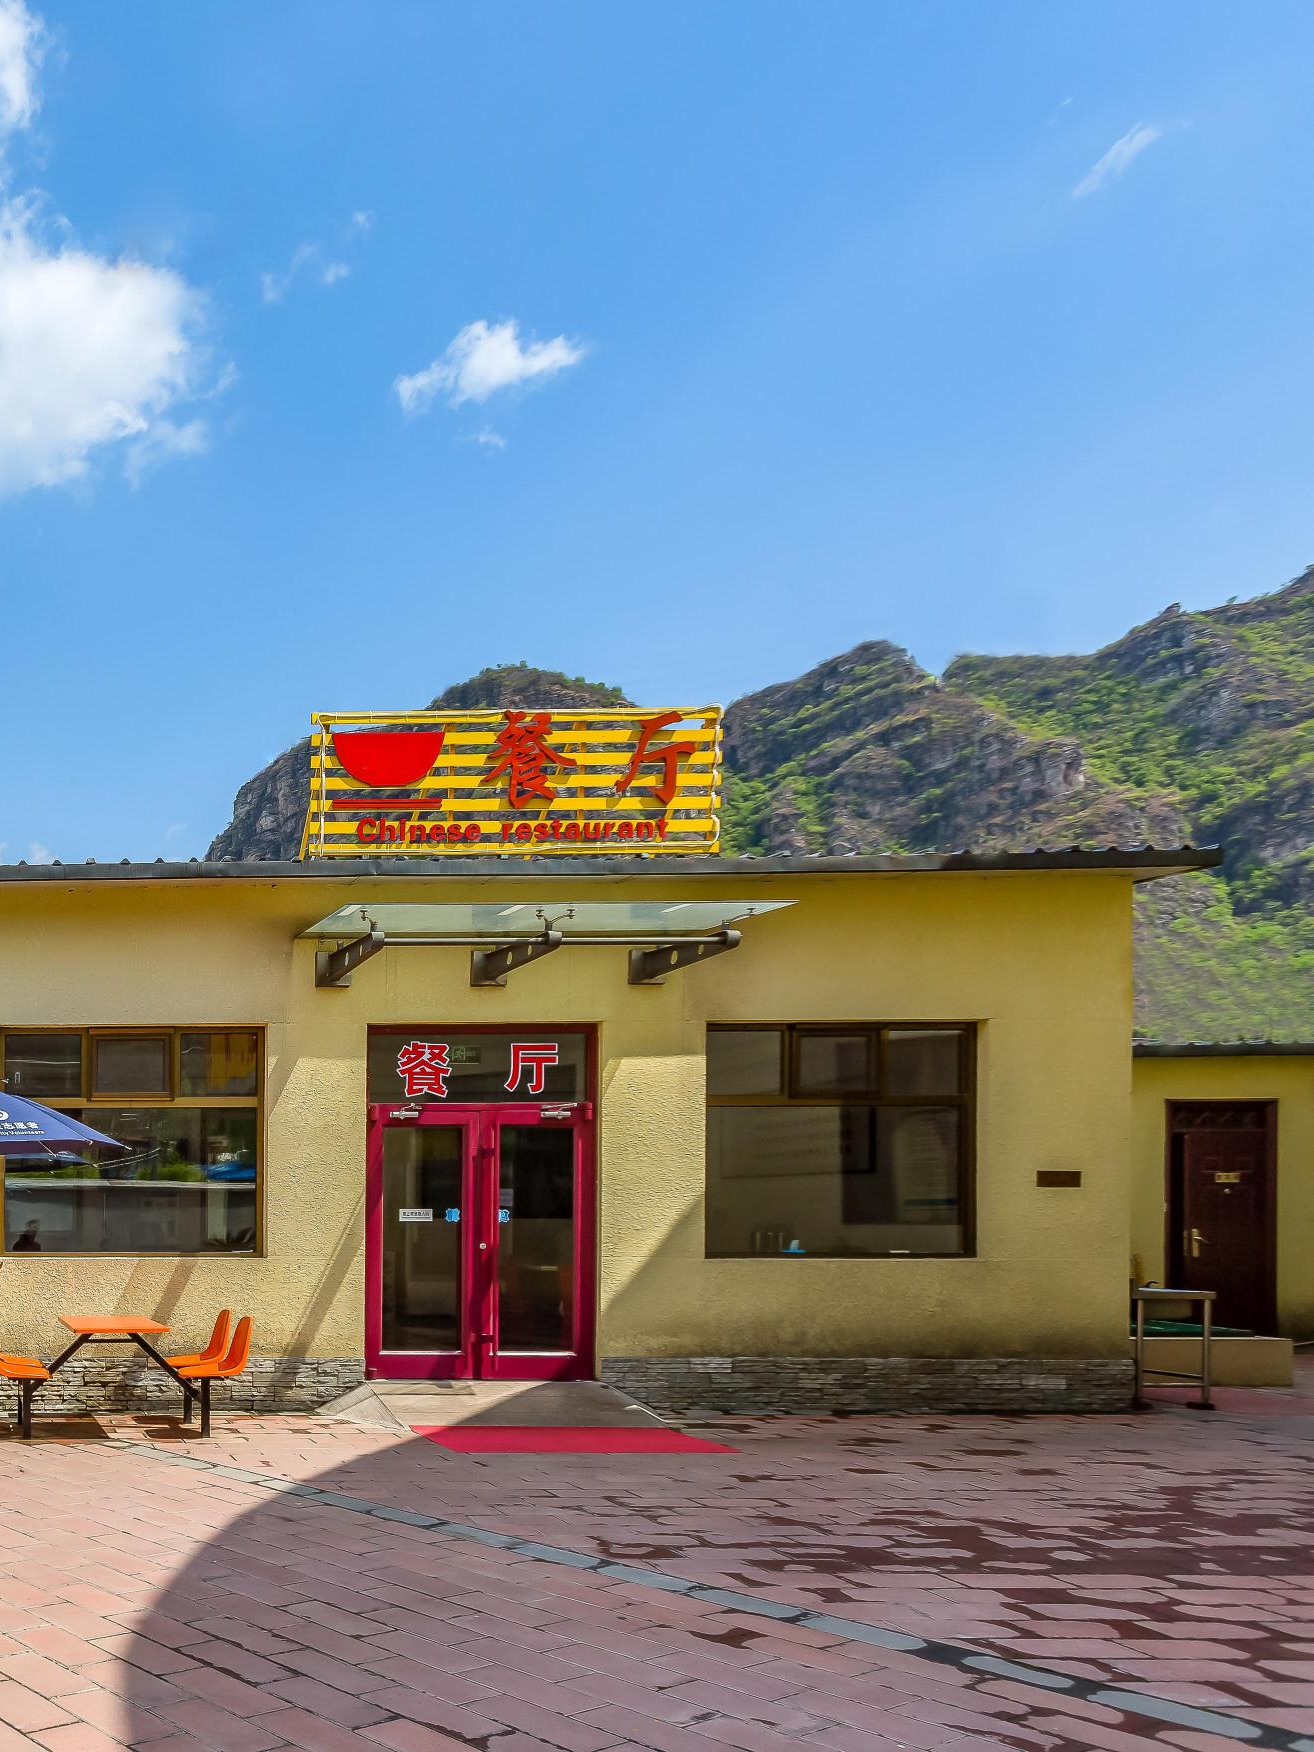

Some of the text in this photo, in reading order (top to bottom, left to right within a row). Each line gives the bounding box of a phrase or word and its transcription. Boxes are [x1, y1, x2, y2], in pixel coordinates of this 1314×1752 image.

[483, 710, 697, 809] 餐厅
[356, 817, 668, 842] Chinese restaurant
[397, 1041, 559, 1098] 餐厅
